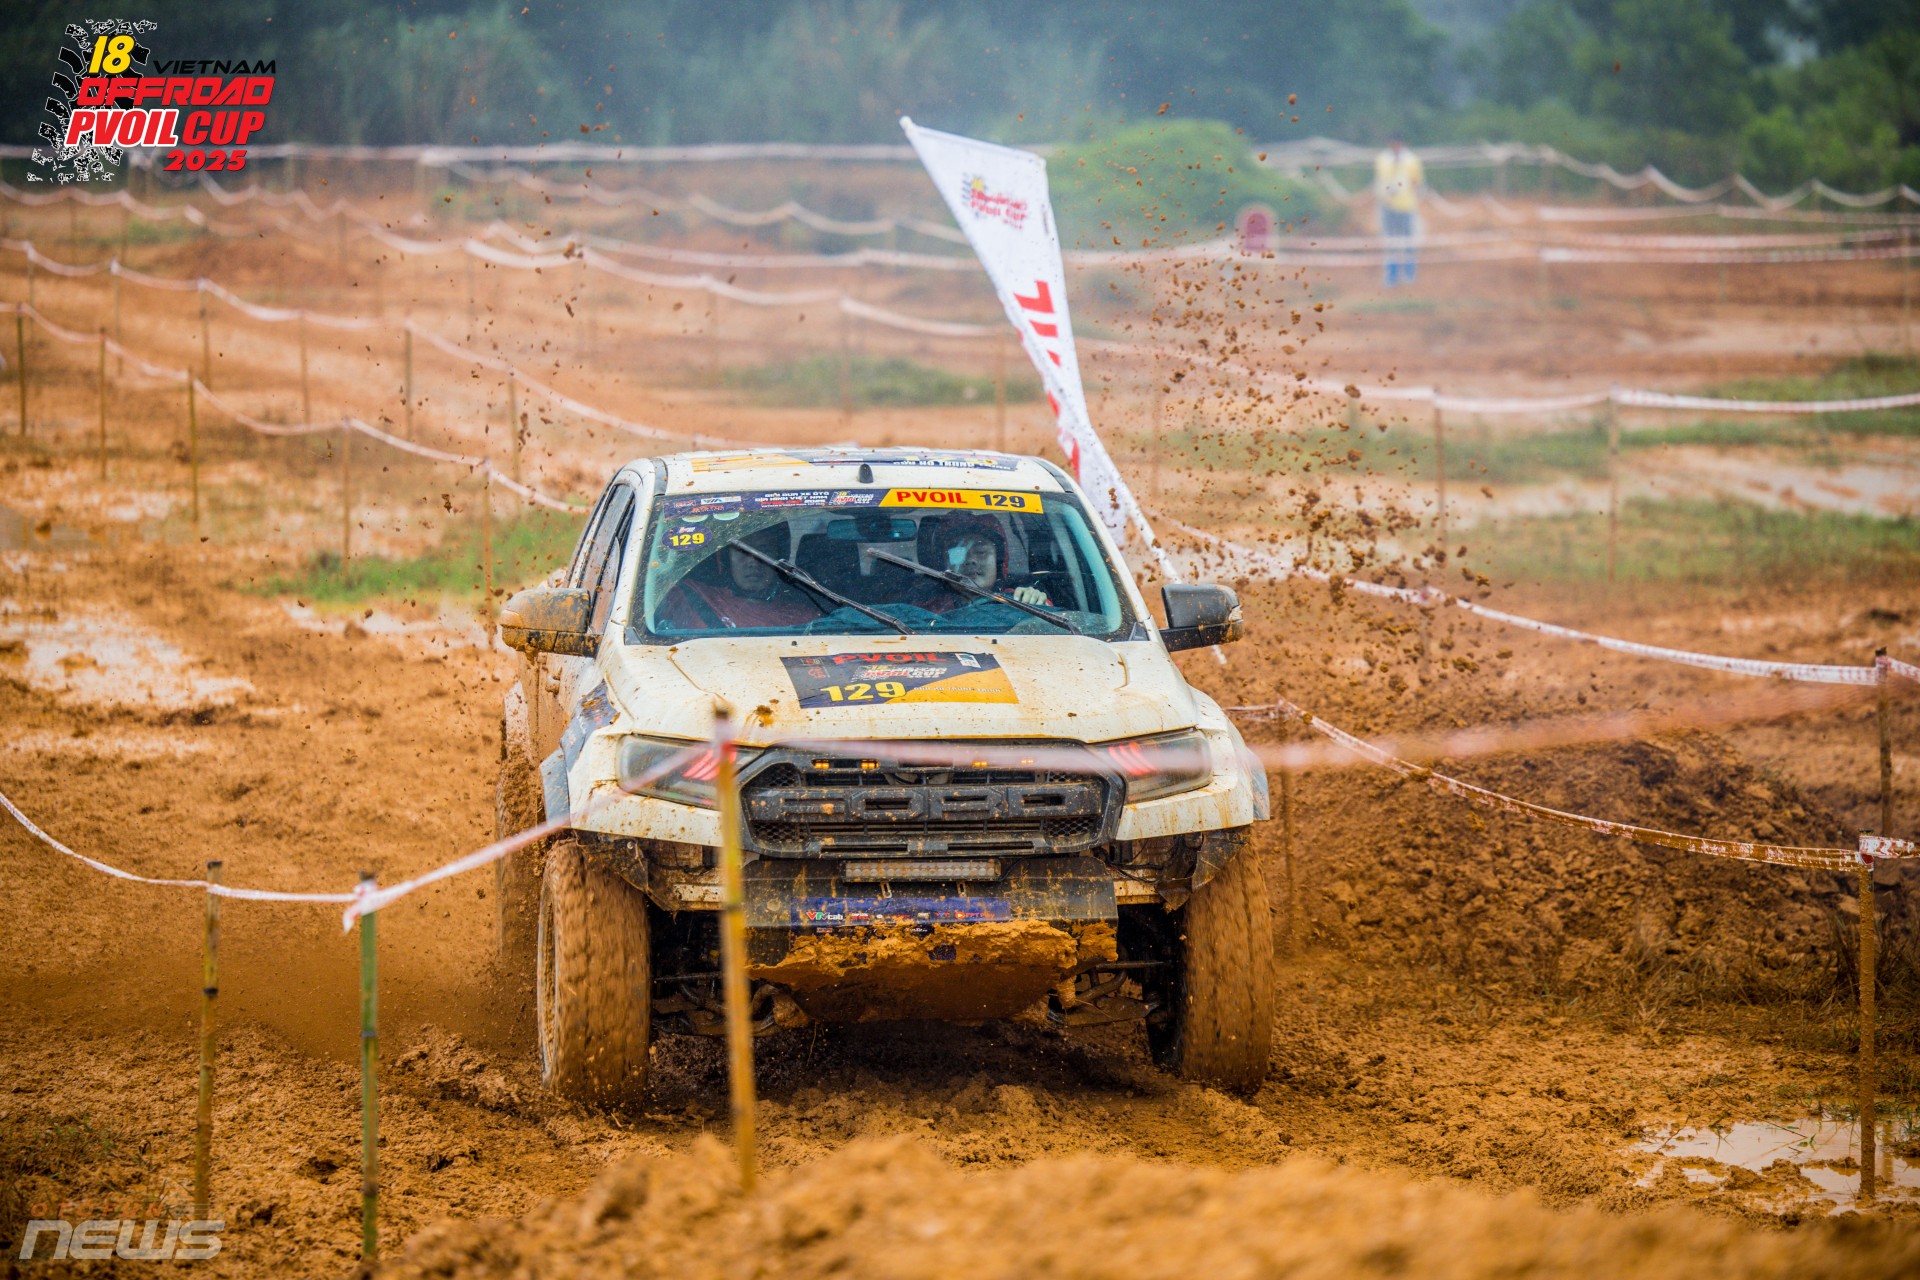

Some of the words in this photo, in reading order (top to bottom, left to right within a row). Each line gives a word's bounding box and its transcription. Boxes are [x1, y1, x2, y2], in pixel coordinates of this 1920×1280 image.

[896, 491, 968, 504] PVOIL
[980, 494, 1026, 508] 129
[669, 532, 705, 547] 129
[833, 652, 948, 665] PVOIL
[820, 681, 906, 702] 129
